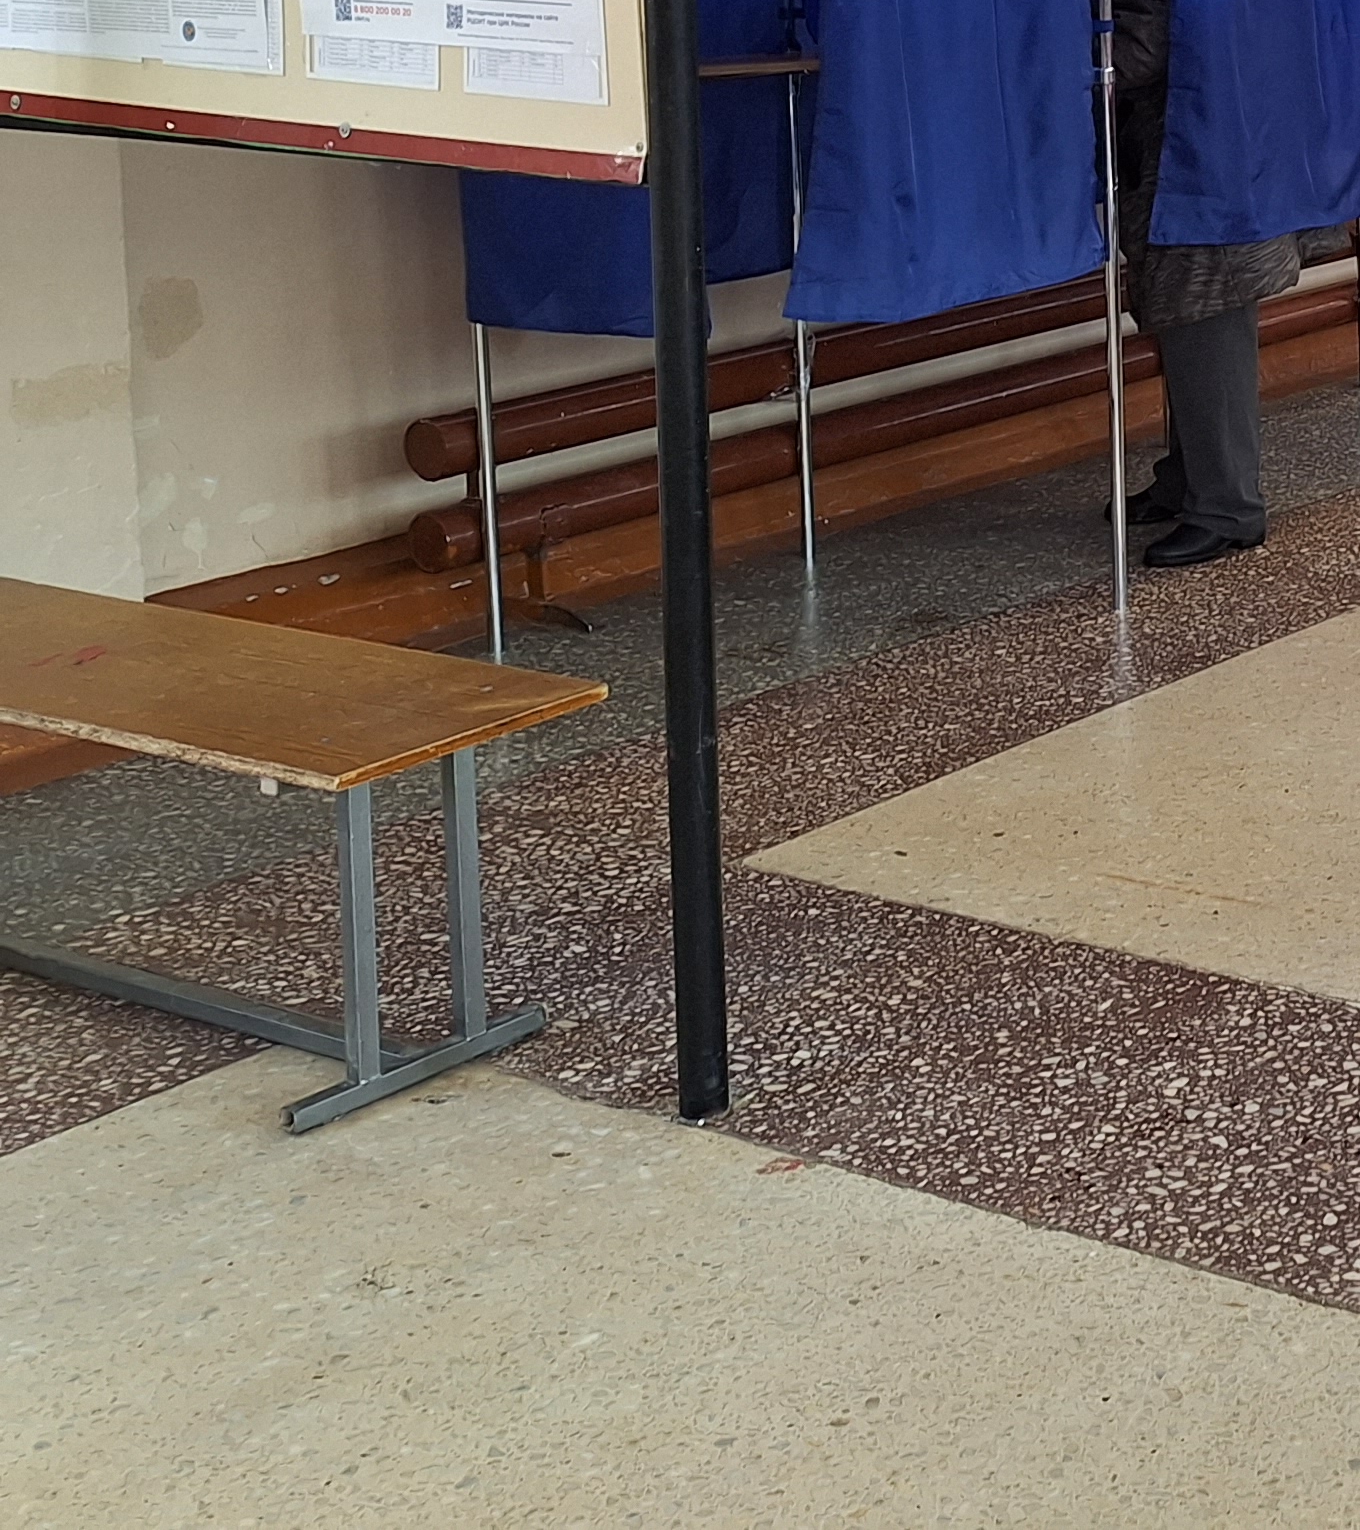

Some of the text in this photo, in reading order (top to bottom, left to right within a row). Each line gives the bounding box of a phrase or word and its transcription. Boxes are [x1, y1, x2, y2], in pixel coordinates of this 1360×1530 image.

[376, 6, 389, 15] 200
[391, 7, 400, 16] 00
[403, 8, 411, 17] 20
